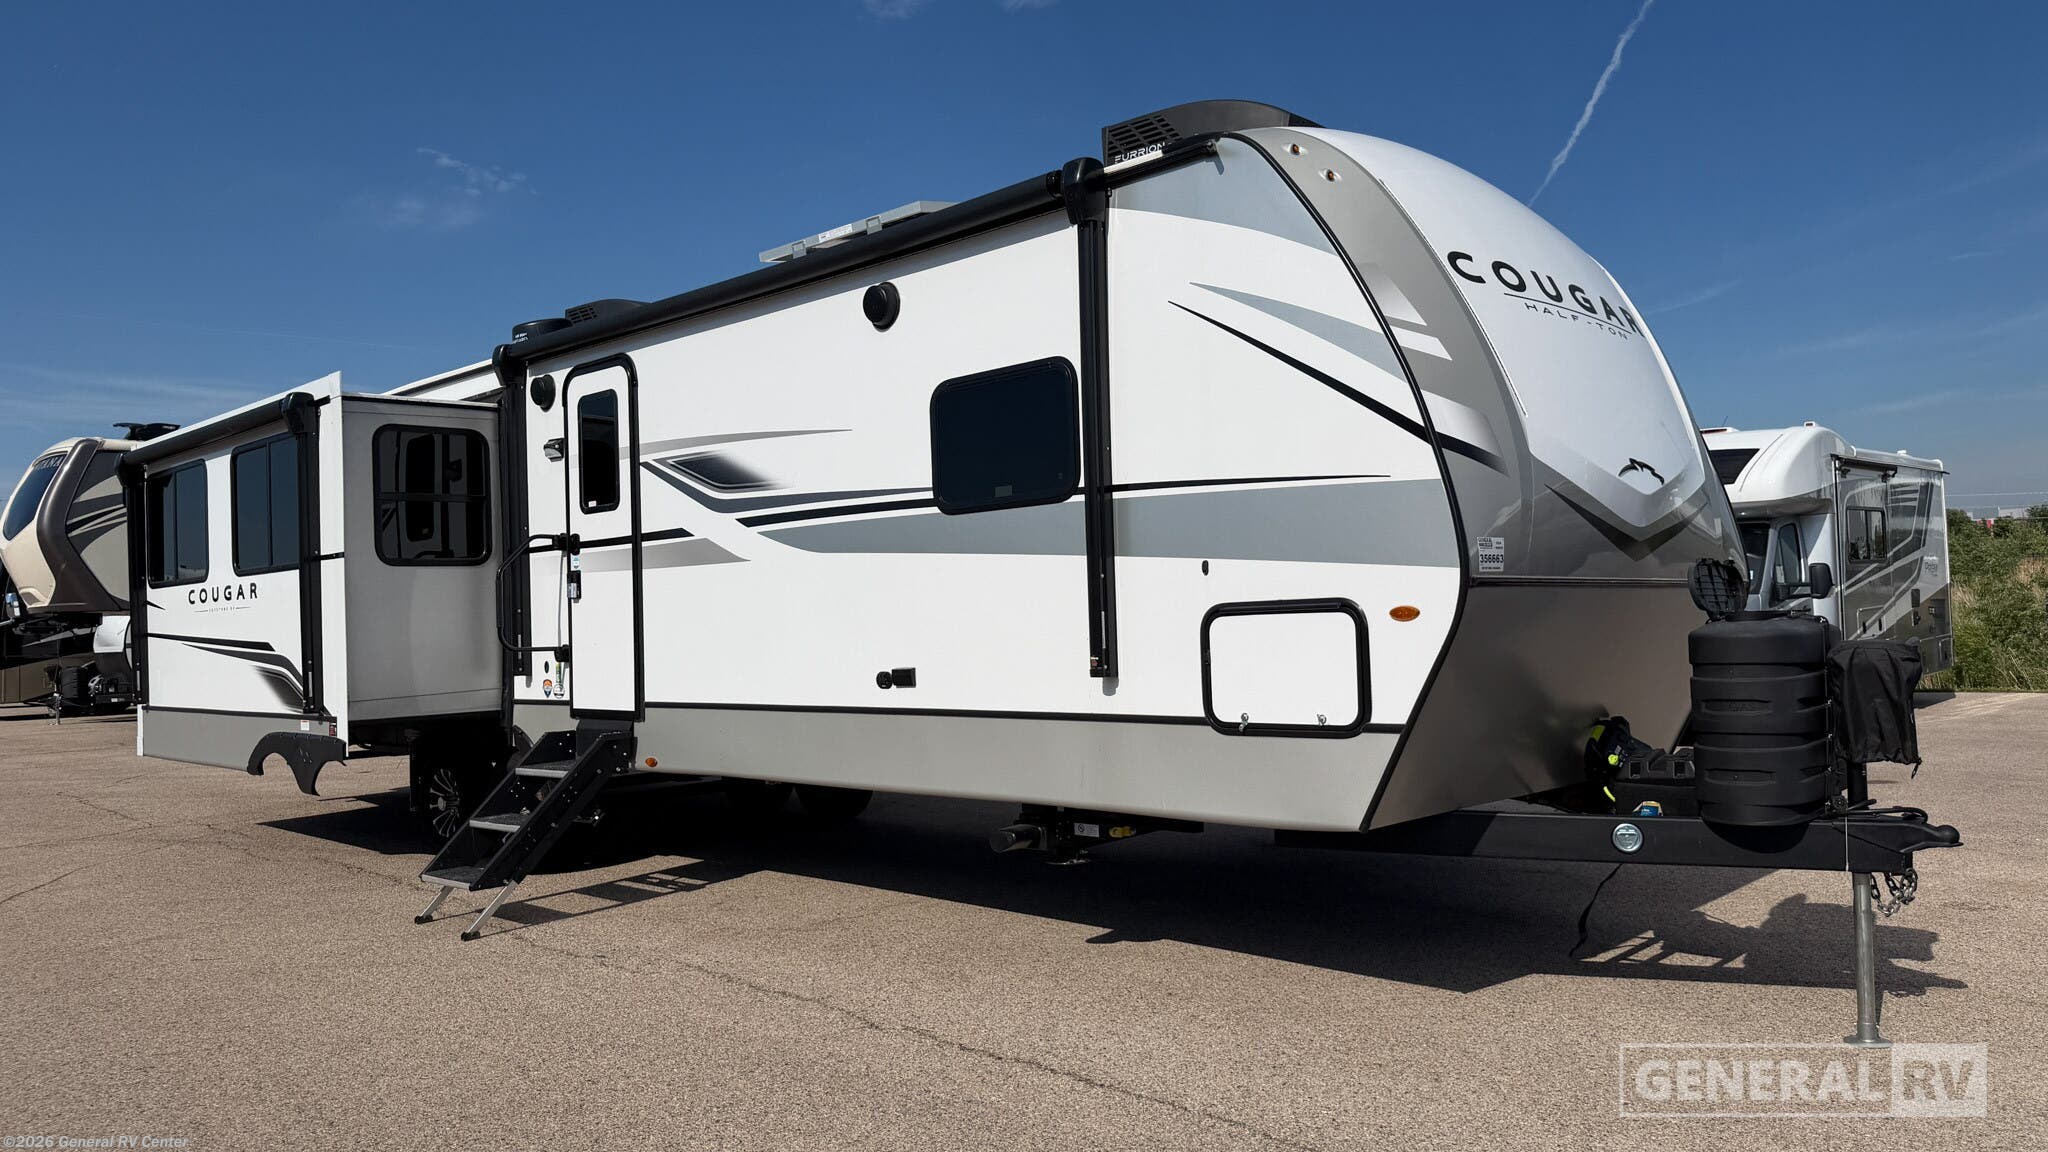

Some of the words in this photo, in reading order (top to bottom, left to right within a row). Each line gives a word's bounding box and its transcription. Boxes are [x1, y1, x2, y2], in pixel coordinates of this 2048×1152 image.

[1114, 141, 1165, 164] FURRION
[1447, 251, 1646, 338] COUGAR
[188, 582, 258, 605] COUGAR
